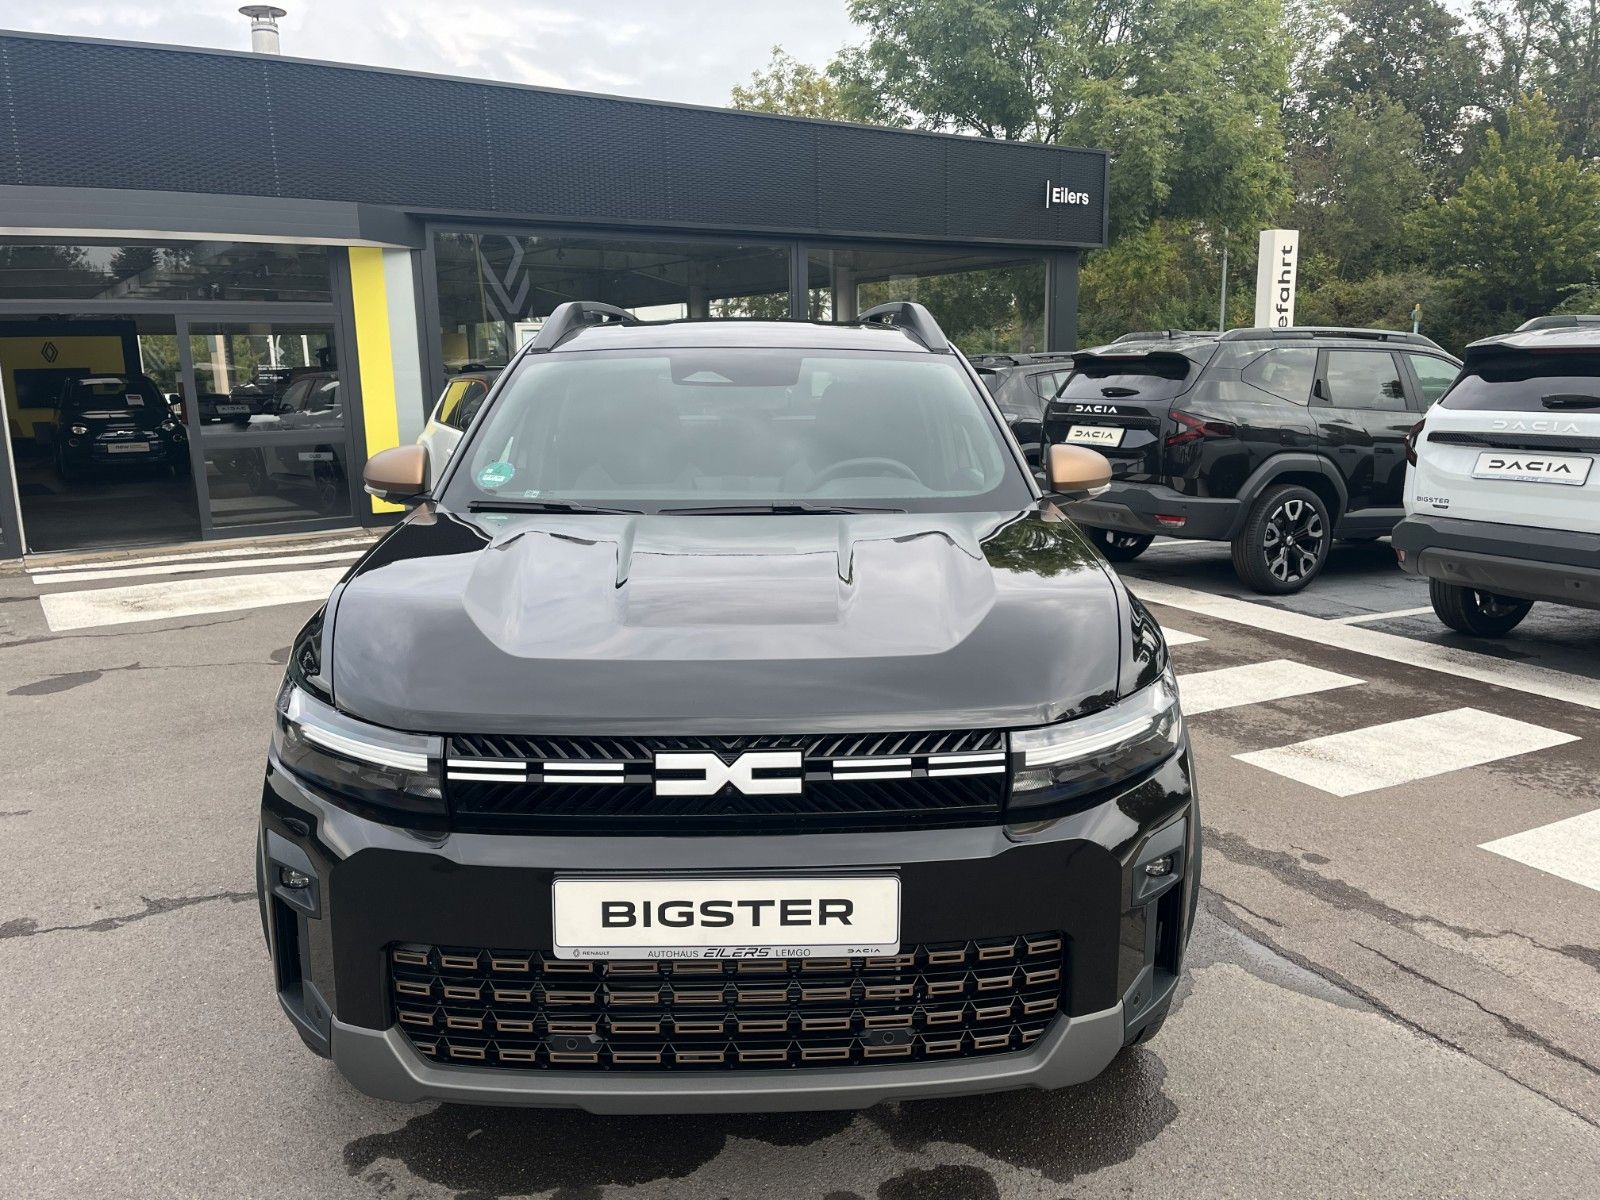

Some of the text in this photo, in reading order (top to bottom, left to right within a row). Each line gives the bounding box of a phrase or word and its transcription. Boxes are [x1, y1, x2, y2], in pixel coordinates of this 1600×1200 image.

[1052, 187, 1089, 205] Eilers
[1075, 405, 1118, 413] DACIA
[1492, 419, 1580, 433] DACIA
[1074, 430, 1113, 439] DACIA
[1488, 459, 1572, 473] DACIA
[1416, 495, 1450, 504] BIGSTER
[602, 898, 854, 928] BIGSTER
[647, 948, 811, 958] AUTOHAUS EILERS LEMGO
